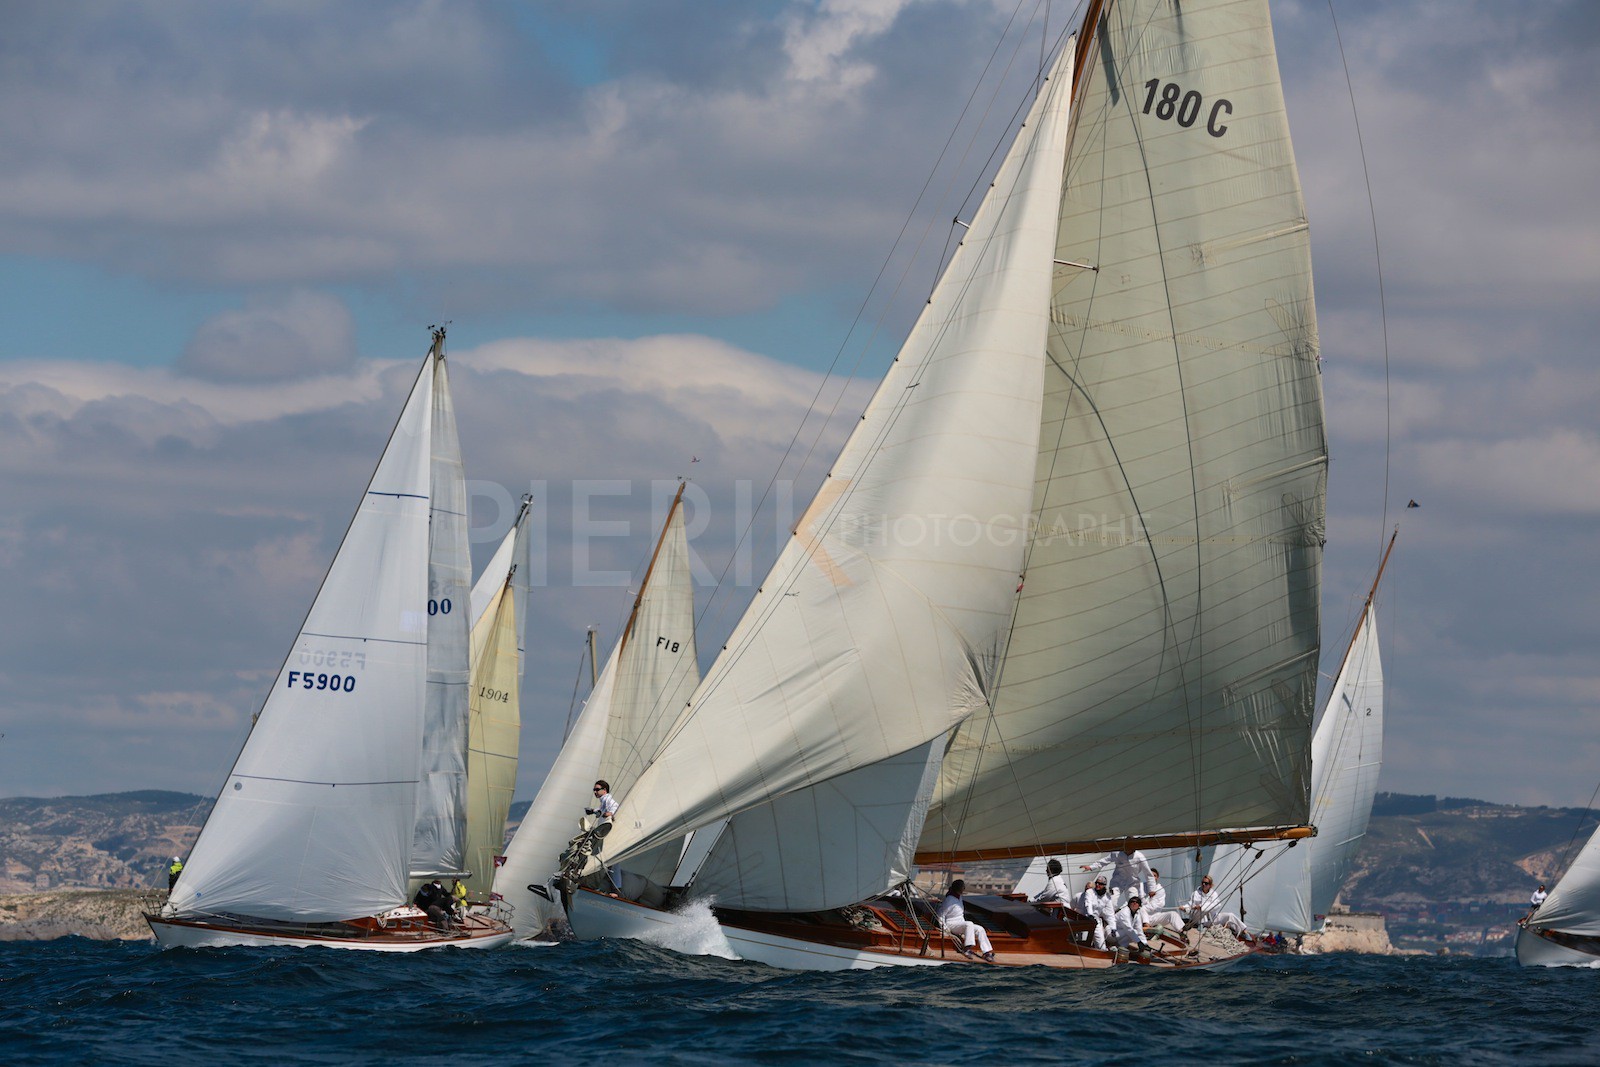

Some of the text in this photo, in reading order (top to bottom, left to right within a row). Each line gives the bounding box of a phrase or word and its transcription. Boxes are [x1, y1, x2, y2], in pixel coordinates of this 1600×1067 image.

[1142, 78, 1233, 138] 180 C
[656, 636, 680, 653] F18
[287, 671, 356, 692] F5900
[479, 686, 509, 703] 1904
